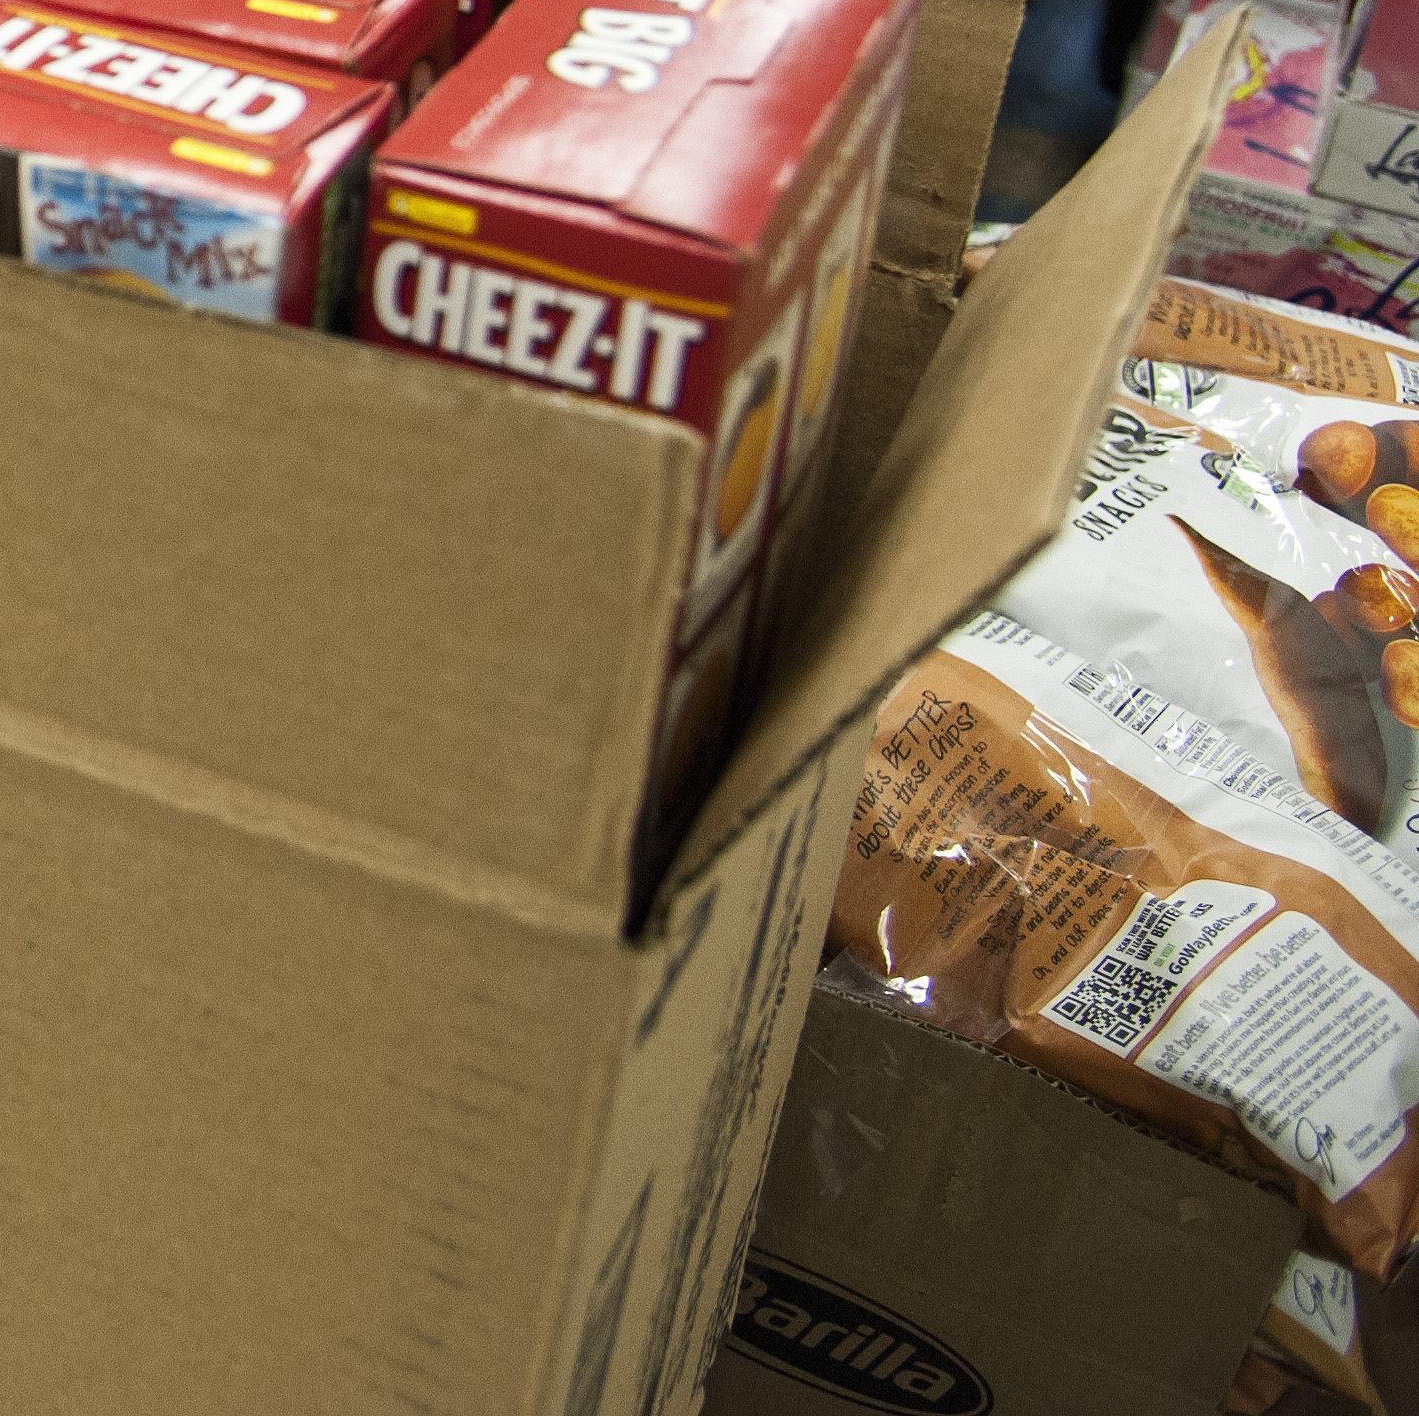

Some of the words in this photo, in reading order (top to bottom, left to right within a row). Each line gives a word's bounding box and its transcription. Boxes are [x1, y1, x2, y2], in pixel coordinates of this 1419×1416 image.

[547, 8, 696, 92] BIG
[36, 188, 185, 256] Snack
[164, 234, 272, 288] Mix
[372, 240, 710, 412] CHEEZ-IT
[1073, 474, 1170, 541] SNACKS
[881, 689, 952, 768] BETTER
[853, 804, 901, 857] about
[893, 760, 933, 803] these
[929, 704, 980, 761] Chips?
[1052, 907, 1075, 932] hard
[1066, 924, 1088, 947] OUR
[1134, 936, 1157, 962] WAY
[1154, 1041, 1182, 1074] eat
[1259, 942, 1285, 970] be
[734, 1272, 956, 1403] Barilla
